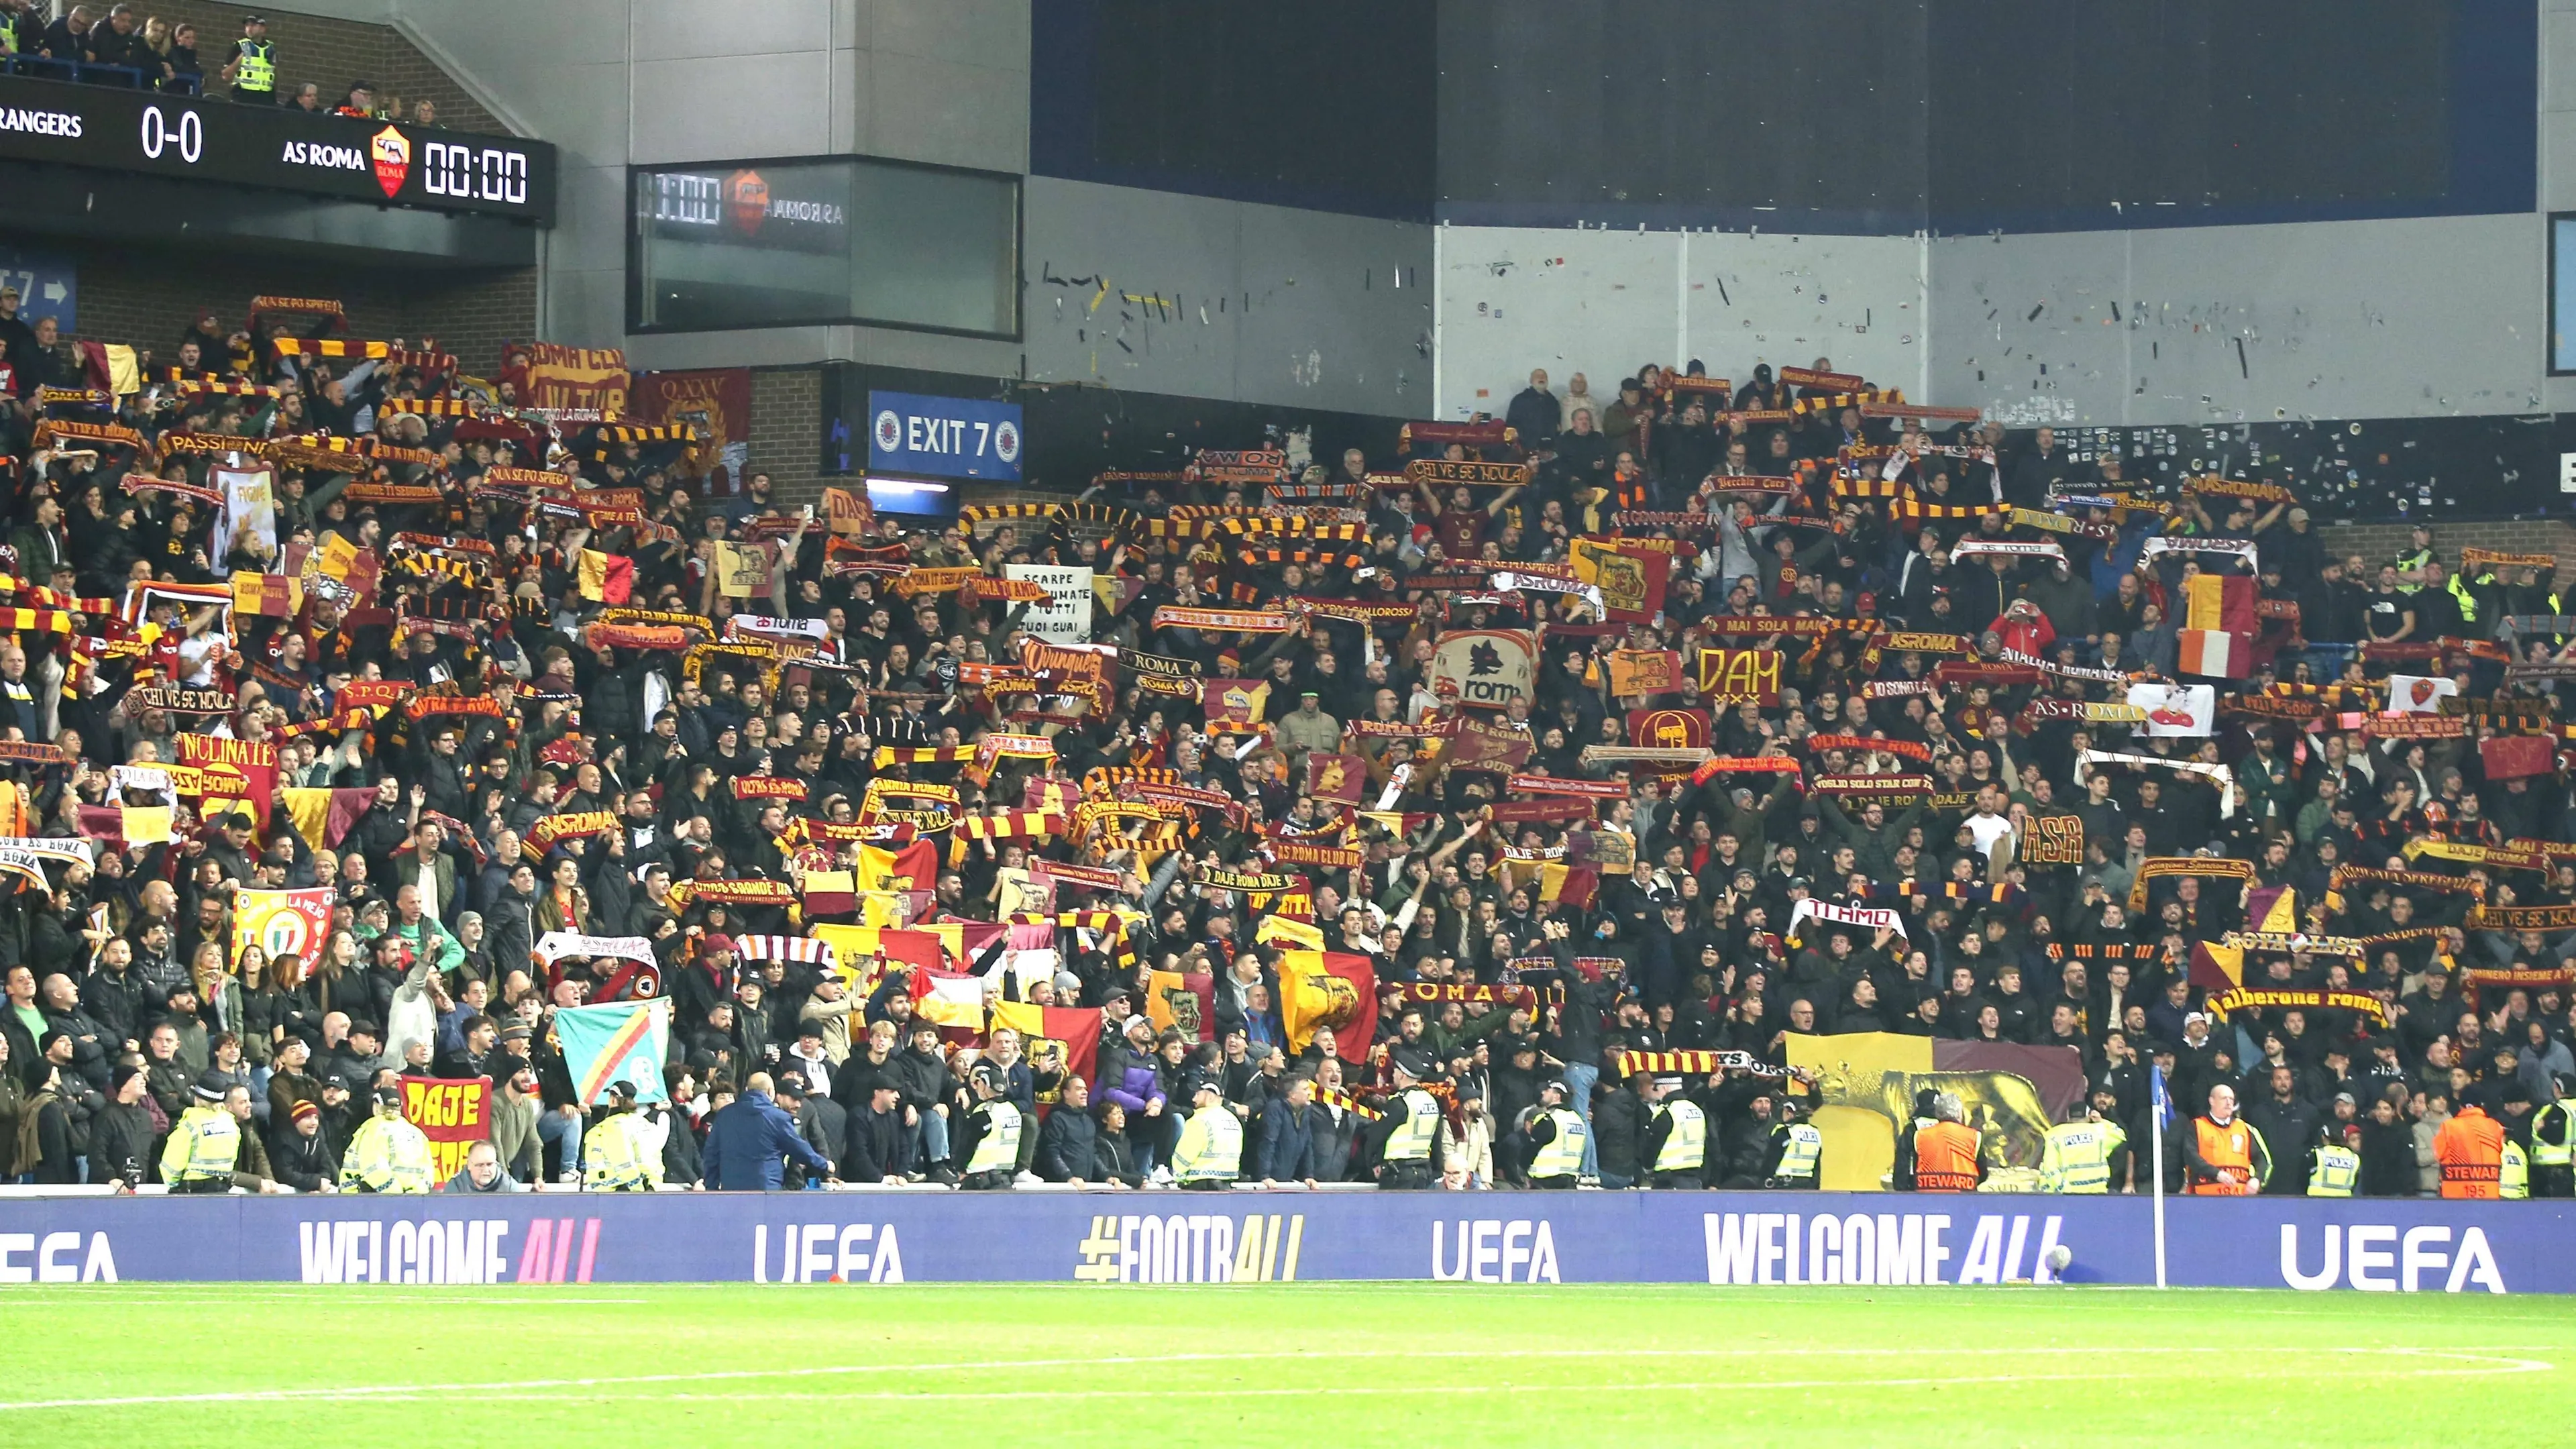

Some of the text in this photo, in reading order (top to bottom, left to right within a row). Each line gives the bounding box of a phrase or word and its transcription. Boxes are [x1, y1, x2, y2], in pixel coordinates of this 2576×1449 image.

[142, 106, 202, 162] 0-0
[283, 142, 366, 170] AS ROMA
[378, 166, 404, 179] ROMA
[426, 143, 526, 203] 00:00
[908, 415, 989, 457] EXIT 7
[2004, 544, 2041, 552] roma
[1023, 574, 1073, 586] SCARPE
[642, 610, 667, 622] CLUB
[773, 618, 808, 632] roma
[1052, 623, 1078, 633] GUAI
[1726, 620, 1750, 632] MAI
[1757, 620, 1788, 632] SOLA
[1134, 653, 1181, 676] ROMA
[1699, 649, 1780, 694] DAM
[1980, 663, 2013, 672] ROMA
[1886, 682, 1916, 696] SONO
[142, 688, 197, 708] CHI VE SE
[1466, 720, 1532, 743] AS ROMA
[182, 733, 274, 766] NCLINATE
[1849, 780, 1874, 789] SOLO
[1875, 779, 1900, 789] STAR
[1936, 794, 1968, 805] DAJE
[2021, 814, 2084, 863] ASR
[1503, 847, 1534, 859] DAJE
[2510, 842, 2536, 853] MAI
[1277, 845, 1360, 866] AS ROMA CLUB UK
[2485, 849, 2530, 861] ROMA
[1214, 872, 1236, 885] DAJE
[729, 882, 773, 894] GRANDE
[287, 896, 302, 908] LA
[1809, 900, 1830, 918] TI
[2549, 909, 2576, 924] NCU
[2513, 971, 2561, 981] INSIEME A
[2222, 987, 2383, 1013] alberone roma
[406, 1081, 482, 1127] DAJE
[2065, 1134, 2093, 1145] POLICE
[2445, 1167, 2499, 1179] STEWAR
[1917, 1175, 1975, 1190] STEWARD
[2464, 1185, 2485, 1197] 195
[299, 1219, 508, 1283] WELCOME
[755, 1223, 904, 1283] UEFA
[1432, 1220, 1561, 1284] UEFA
[1703, 1213, 1951, 1285] WELCOME
[2280, 1224, 2506, 1294] UEFA
